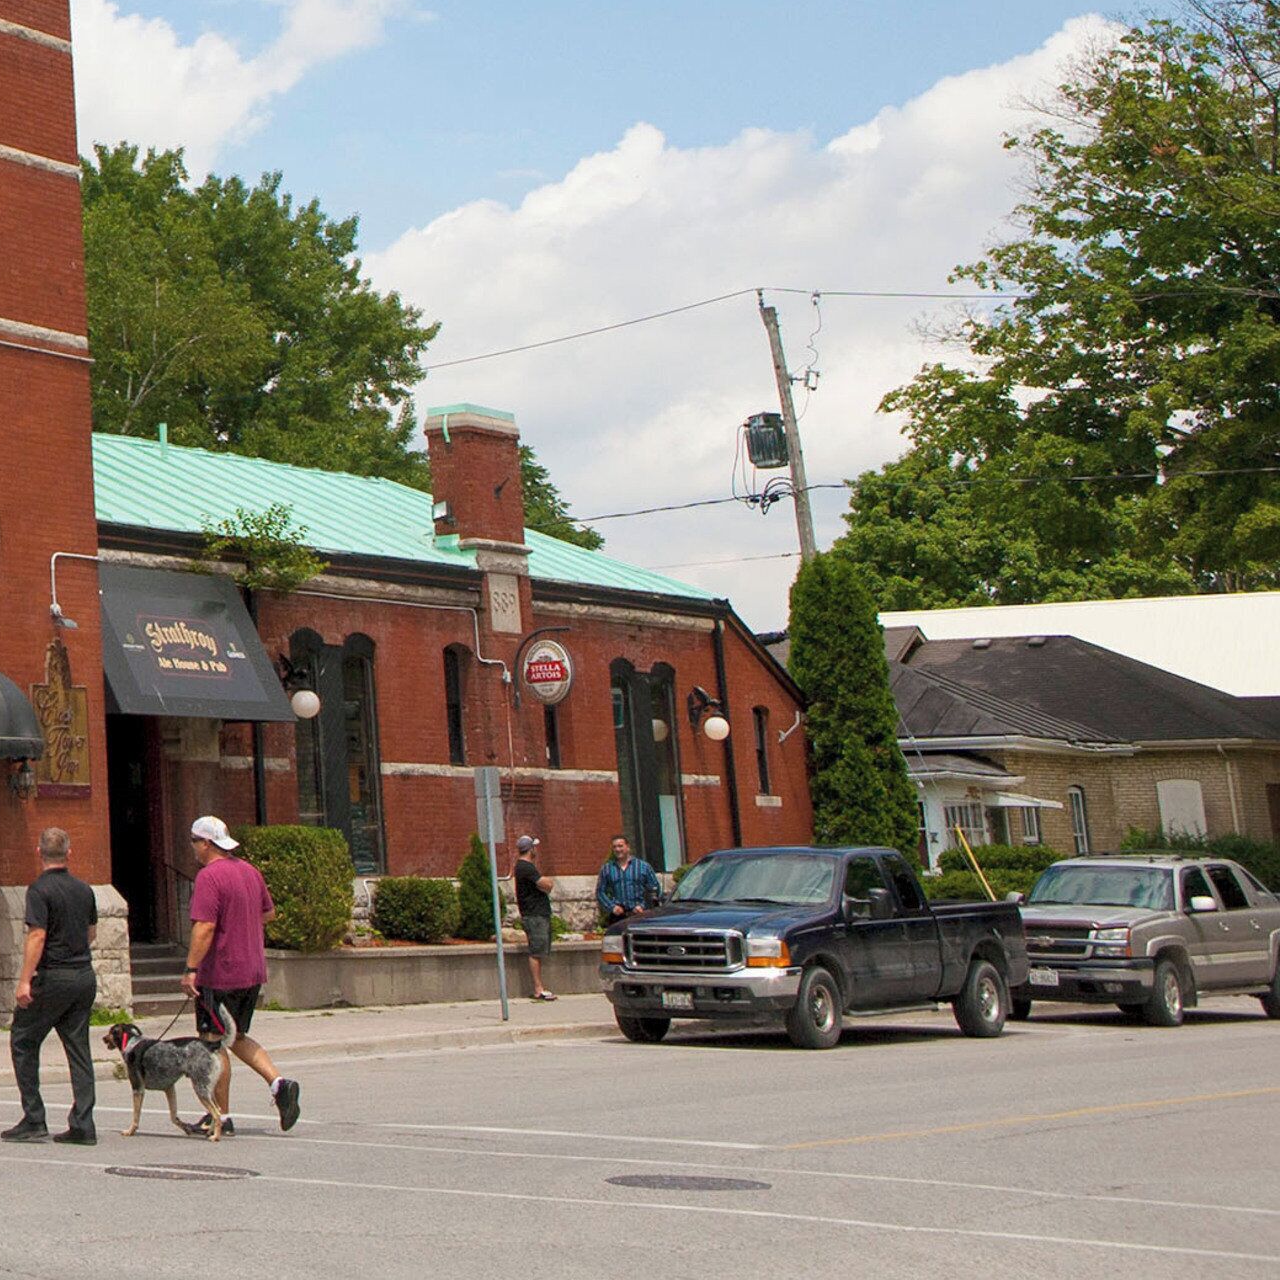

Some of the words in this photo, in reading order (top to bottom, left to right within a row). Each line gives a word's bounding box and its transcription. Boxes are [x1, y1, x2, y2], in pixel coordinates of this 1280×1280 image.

[145, 622, 218, 657] Strathroy
[158, 656, 173, 669] Ale
[173, 657, 200, 671] House
[210, 660, 228, 673] Pub
[531, 664, 561, 673] STELLA
[531, 671, 562, 680] ARTOIS
